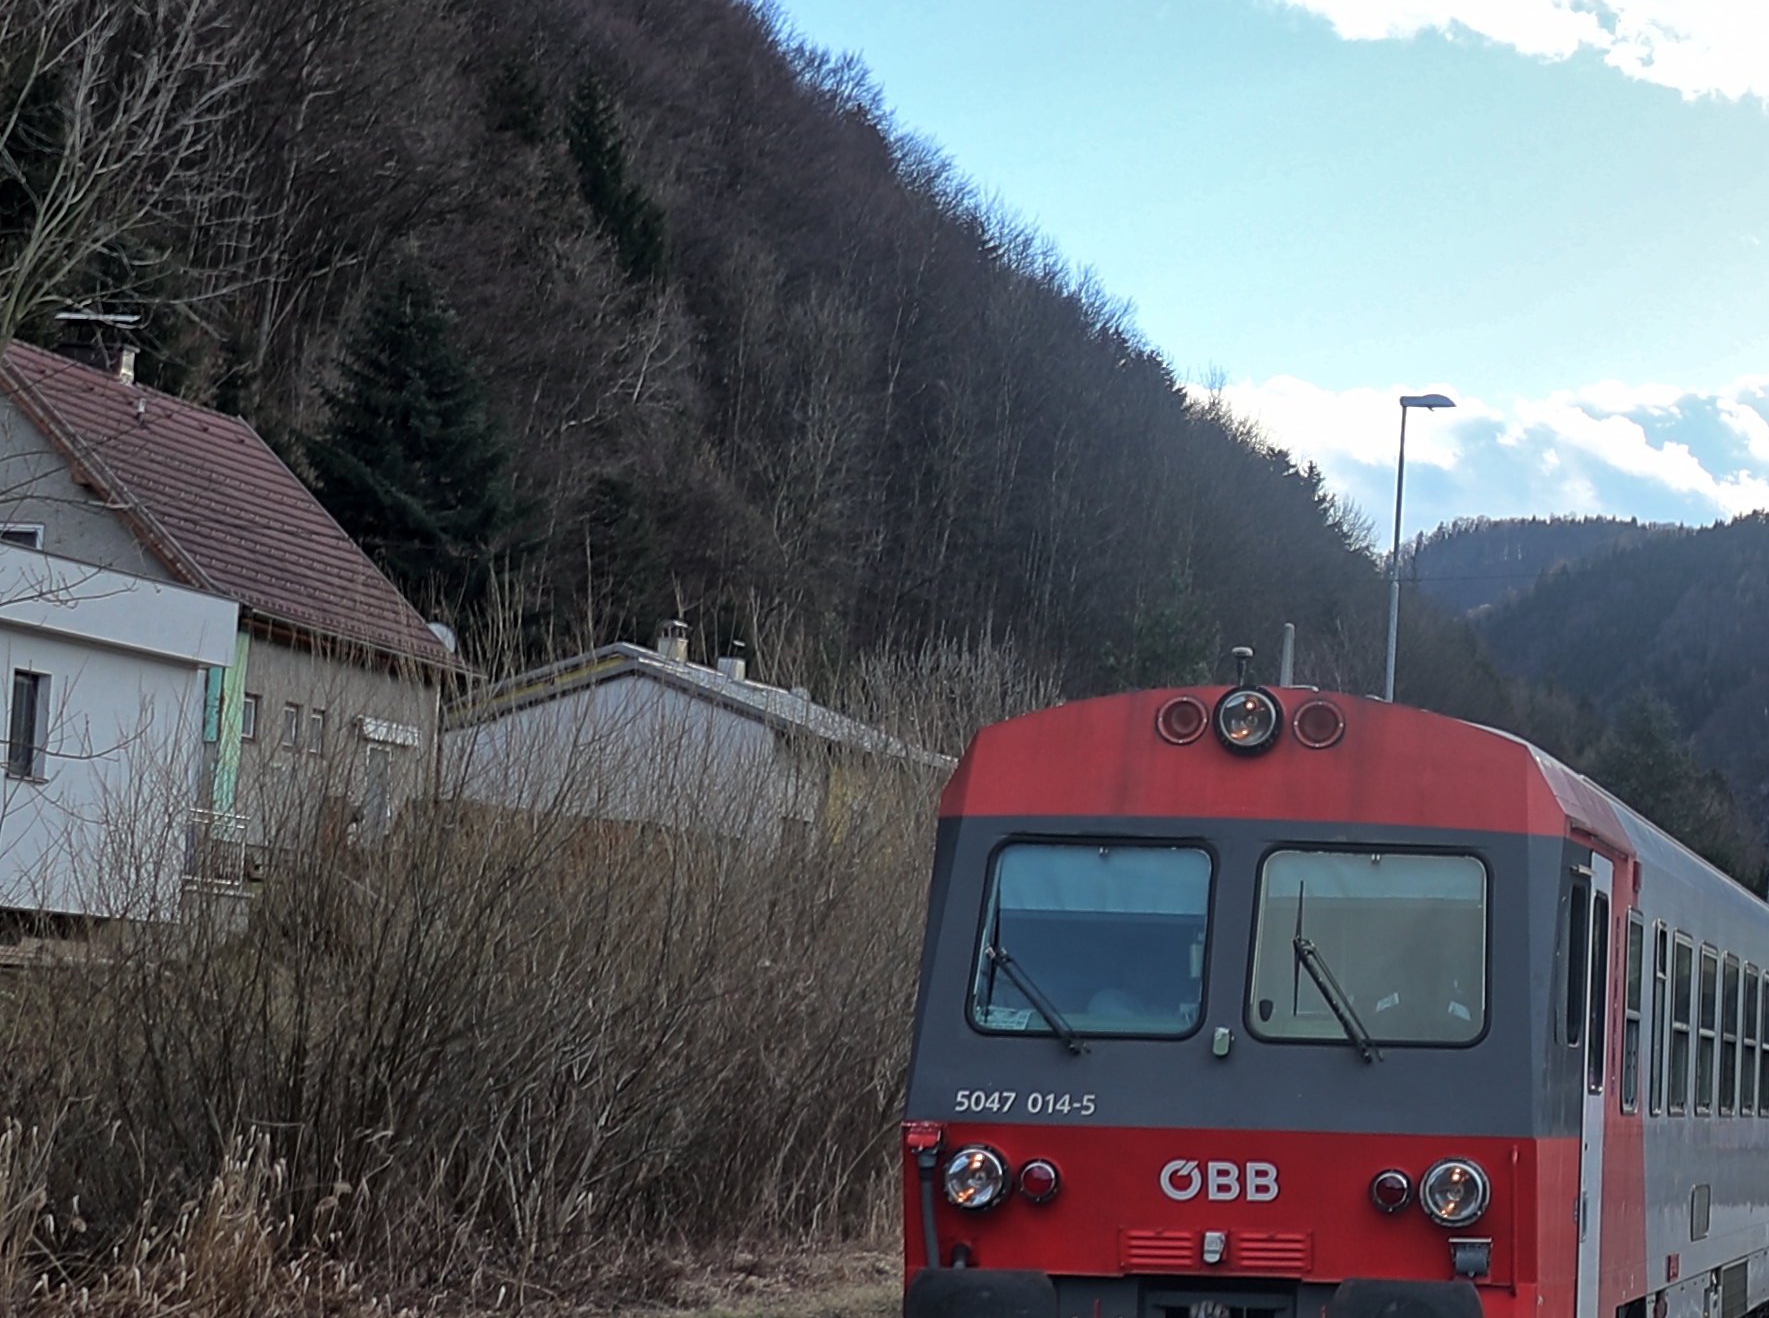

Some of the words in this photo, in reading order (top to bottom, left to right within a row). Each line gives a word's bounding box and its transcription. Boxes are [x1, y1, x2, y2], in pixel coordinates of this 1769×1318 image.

[953, 1089, 1017, 1114] 5047
[1026, 1092, 1097, 1116] 014-5
[1158, 1158, 1280, 1202] ÖBB
